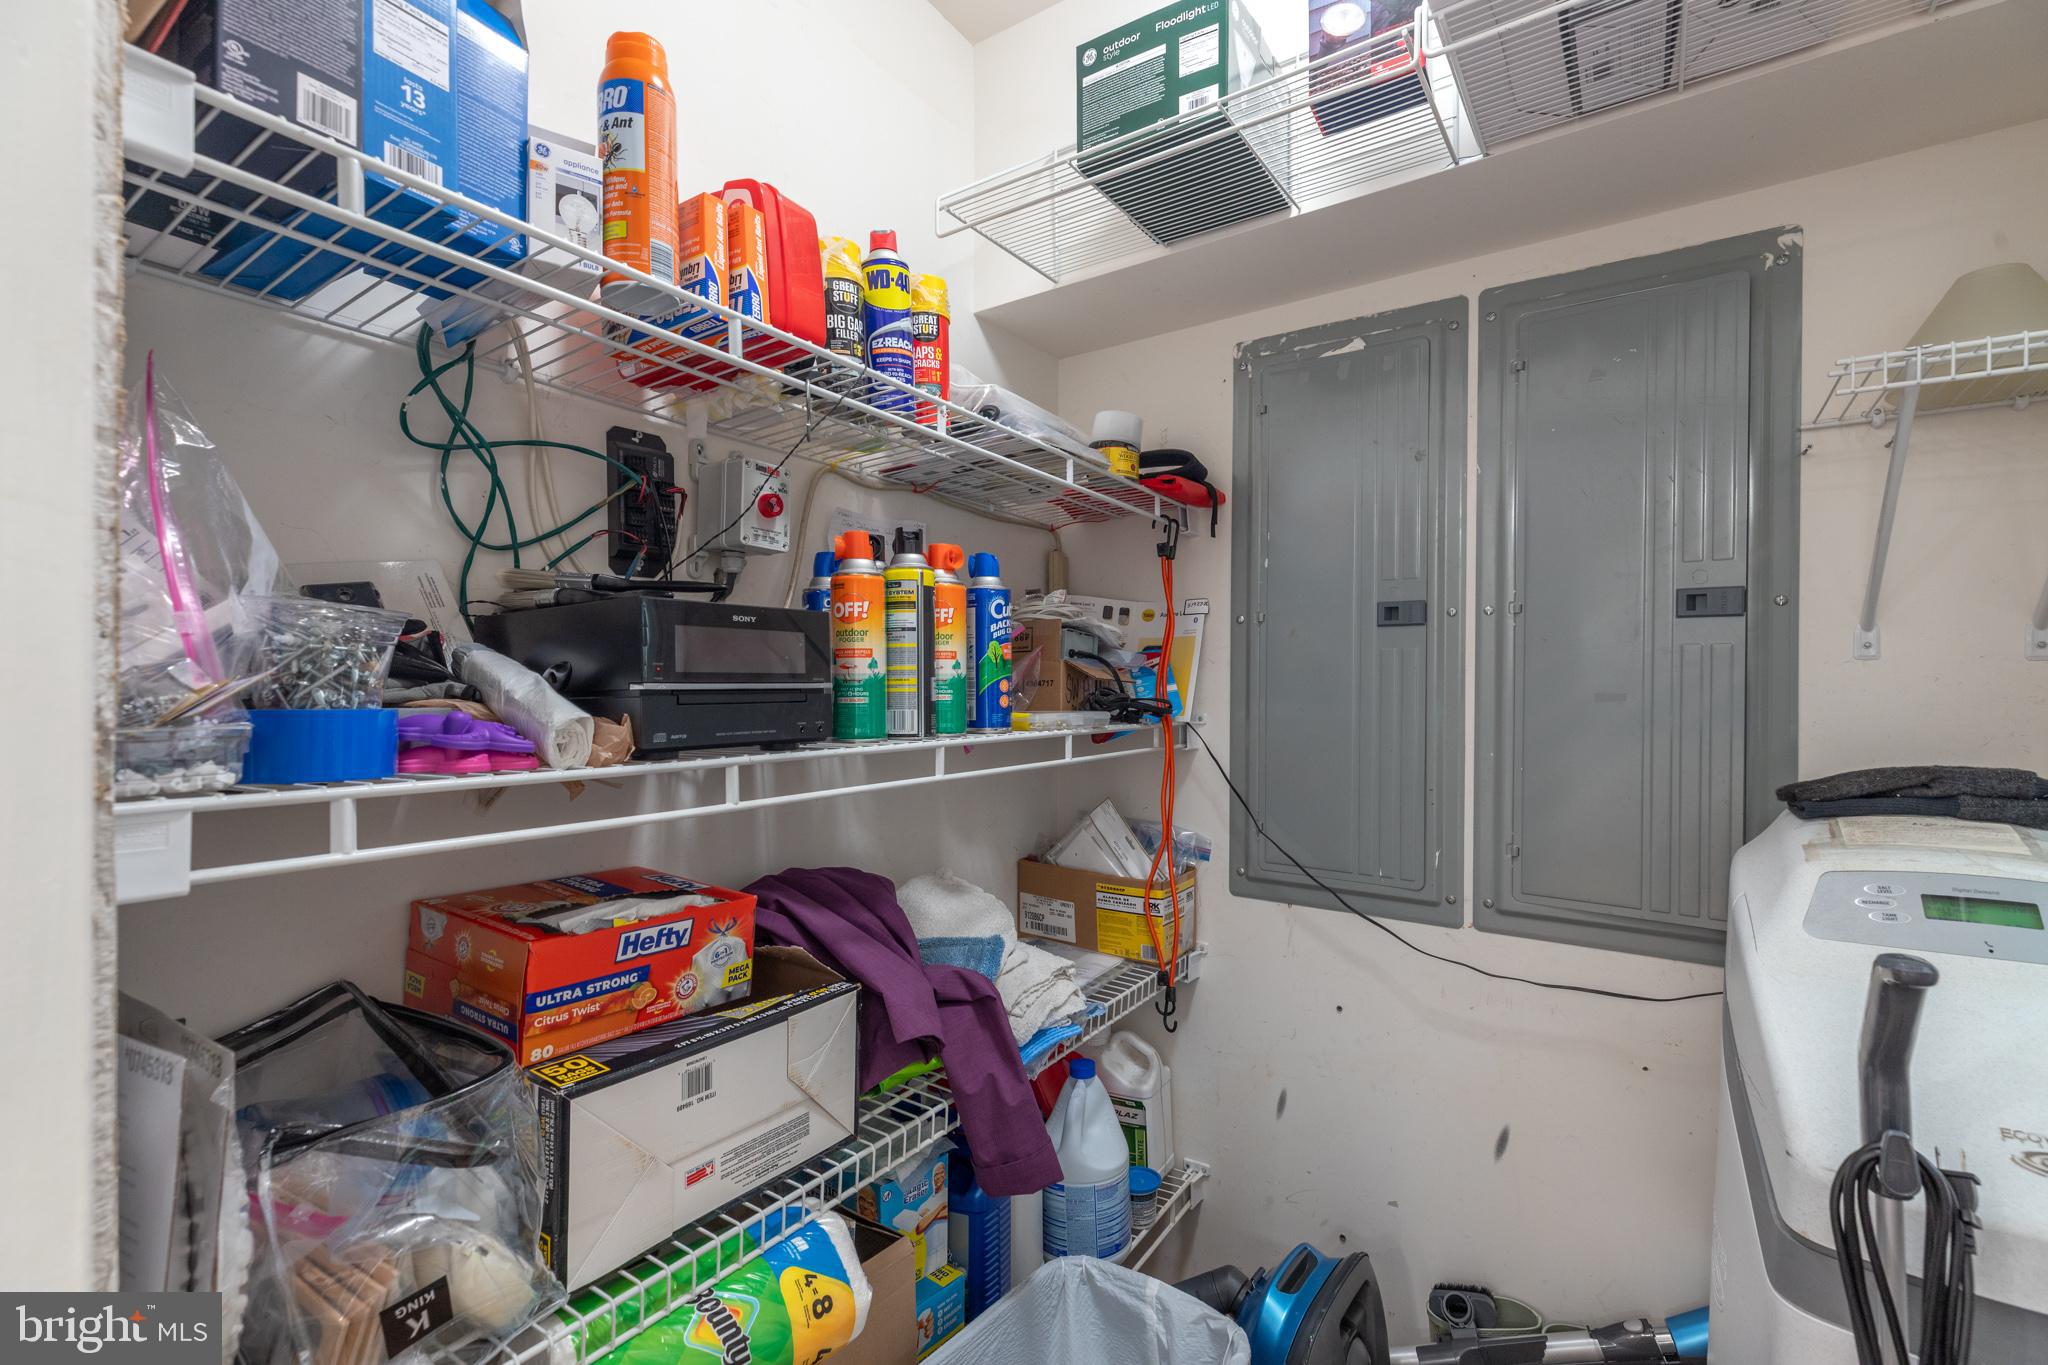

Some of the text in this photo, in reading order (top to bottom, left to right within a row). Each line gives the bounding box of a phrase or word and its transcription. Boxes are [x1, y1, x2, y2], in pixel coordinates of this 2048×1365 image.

[1155, 2, 1219, 32] Floodlight LED
[1102, 32, 1141, 54] outdoor
[1102, 49, 1121, 61] style
[400, 85, 426, 110] 13
[598, 85, 630, 114] RO
[611, 116, 634, 129] Ant
[563, 159, 600, 175] appliance
[715, 202, 724, 226] Baits
[717, 242, 725, 271] Liquid
[583, 261, 599, 271] BULB
[832, 280, 858, 295] GREAT
[866, 269, 911, 295] WD-40
[832, 290, 858, 306] STUFF
[826, 314, 863, 334] BIG GAP
[914, 315, 937, 324] GREAT
[835, 328, 859, 342] FILLER
[914, 325, 938, 336] STUFF
[872, 337, 914, 351] EZ-REACH
[914, 346, 943, 361] APS &
[834, 600, 870, 619] OFF!
[935, 608, 954, 624] FF!
[732, 614, 757, 622] SONY
[835, 629, 869, 638] outdoor
[935, 632, 954, 640] door
[992, 629, 1006, 639] BUG
[621, 926, 689, 957] Hefty
[728, 963, 750, 976] MEGA
[728, 972, 748, 984] PACK
[535, 973, 638, 1007] ULTRA STRONG
[460, 1005, 509, 1035] ULTRA STRONG
[534, 1003, 600, 1028] Citrus Twist
[530, 1045, 554, 1062] 80
[540, 1058, 588, 1076] 50
[556, 1065, 598, 1081] BAGS
[1137, 1139, 1145, 1161] MATTE
[394, 1289, 436, 1320] KING
[405, 1308, 430, 1340] K
